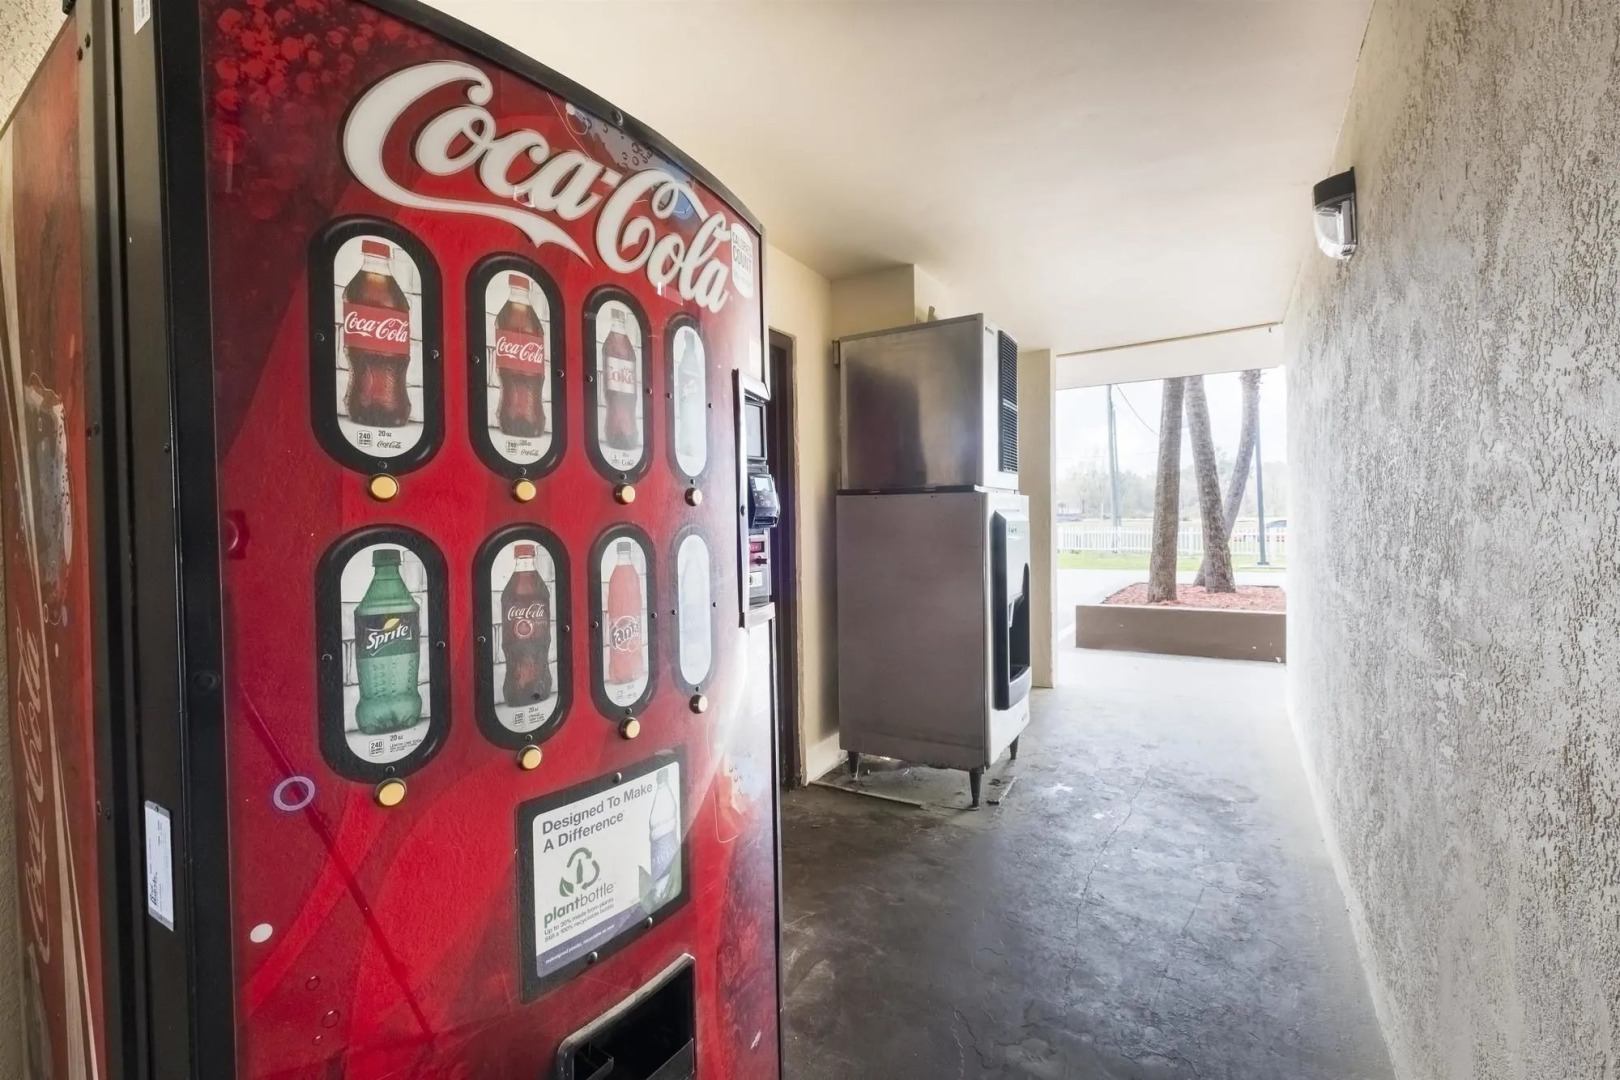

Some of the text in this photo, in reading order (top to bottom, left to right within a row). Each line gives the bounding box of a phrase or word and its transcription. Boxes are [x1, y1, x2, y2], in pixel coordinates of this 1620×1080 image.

[343, 60, 731, 313] Coca-Cola
[733, 245, 752, 273] COUNT
[344, 311, 409, 342] Coca-Cola
[496, 336, 544, 363] Coca-Cola
[359, 432, 371, 440] 240
[507, 603, 545, 620] Coca-Cola
[366, 624, 409, 650] Sprite
[371, 741, 382, 749] 240
[16, 603, 50, 964] Coca-Cola
[542, 783, 653, 835] Designed To Make
[543, 812, 624, 853] A Difference
[543, 882, 615, 929] plantbottle
[544, 928, 552, 936] Up
